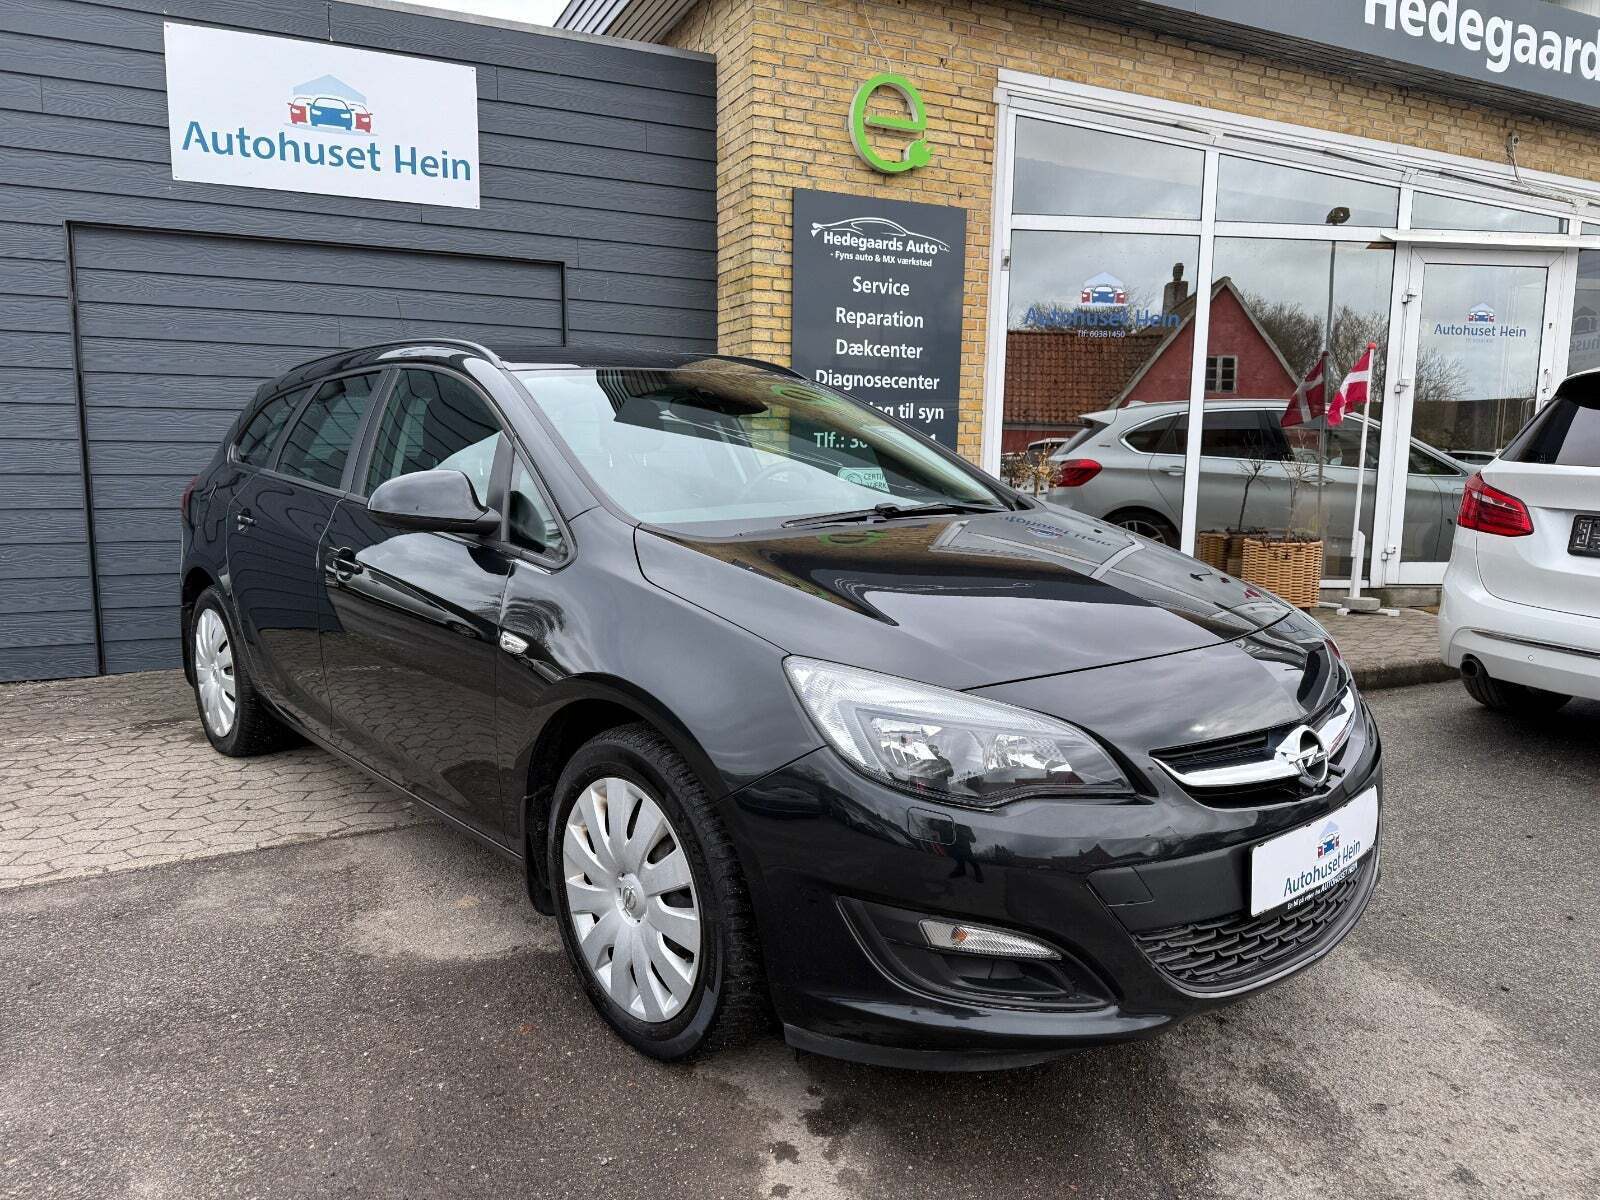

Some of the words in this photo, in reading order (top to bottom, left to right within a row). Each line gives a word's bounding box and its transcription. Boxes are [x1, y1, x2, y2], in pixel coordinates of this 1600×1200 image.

[182, 121, 381, 172] Autohuset
[395, 144, 471, 181] Hein
[823, 231, 903, 251] Hedegaards
[906, 240, 938, 255] Auto
[835, 250, 853, 260] Fyns
[855, 254, 874, 262] auto
[875, 254, 881, 262] &
[882, 255, 896, 264] MX
[897, 257, 932, 267] værksted
[852, 275, 910, 296] Service
[836, 306, 924, 329] Reparation
[1023, 306, 1129, 327] Autohuset
[1135, 309, 1181, 327] Hein
[1433, 323, 1496, 337] Autohuset
[1500, 325, 1527, 338] Hein
[836, 338, 923, 359] Dækcenter
[815, 369, 940, 390] Diagnosecenter
[898, 402, 914, 418] til
[918, 407, 944, 423] syn
[814, 432, 845, 448] Tlf.:
[1283, 854, 1341, 897] Autohuset
[1342, 840, 1361, 865] Hein
